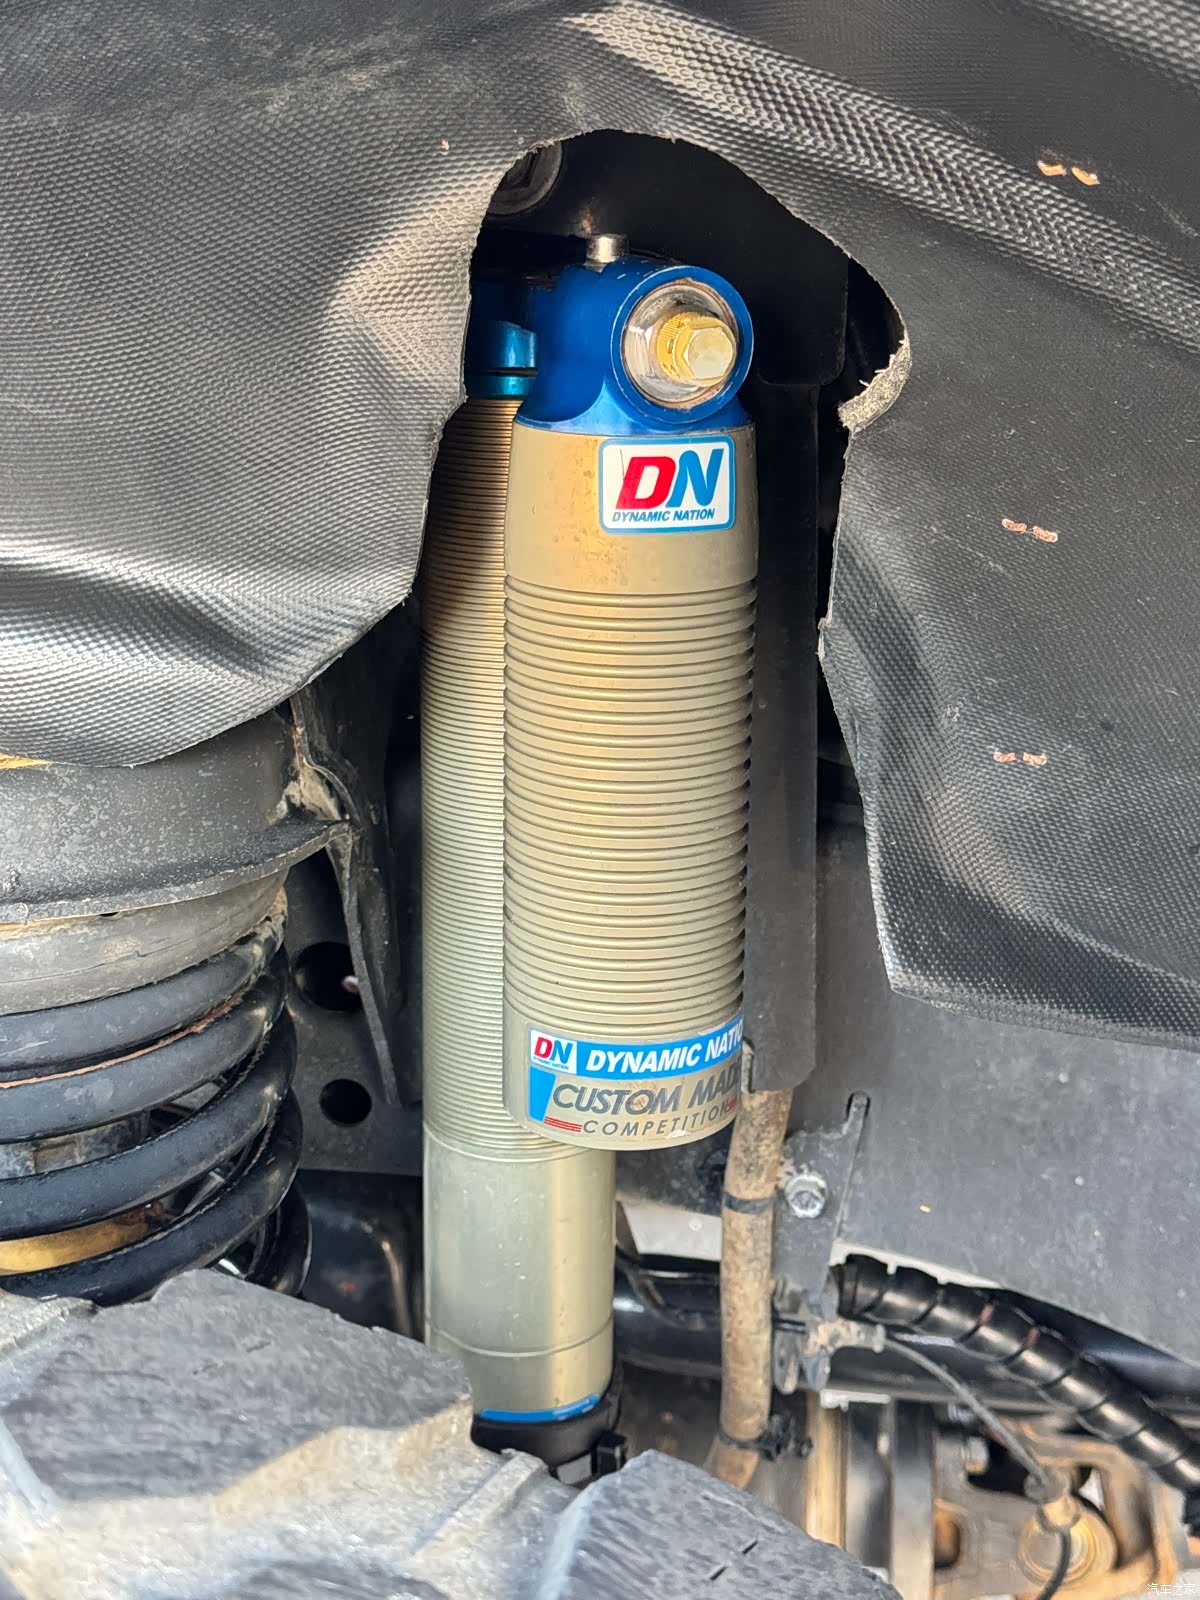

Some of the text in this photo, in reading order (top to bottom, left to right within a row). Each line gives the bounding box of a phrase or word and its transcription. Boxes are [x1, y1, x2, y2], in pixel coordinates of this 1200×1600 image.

[616, 448, 724, 510] DN
[612, 509, 715, 522] DYNAMIC NATION
[533, 1036, 573, 1064] DN
[586, 1019, 743, 1074] DYNAMIC NATIO
[552, 1084, 683, 1116] CUSTOM
[583, 1100, 729, 1137] COMPETITION
